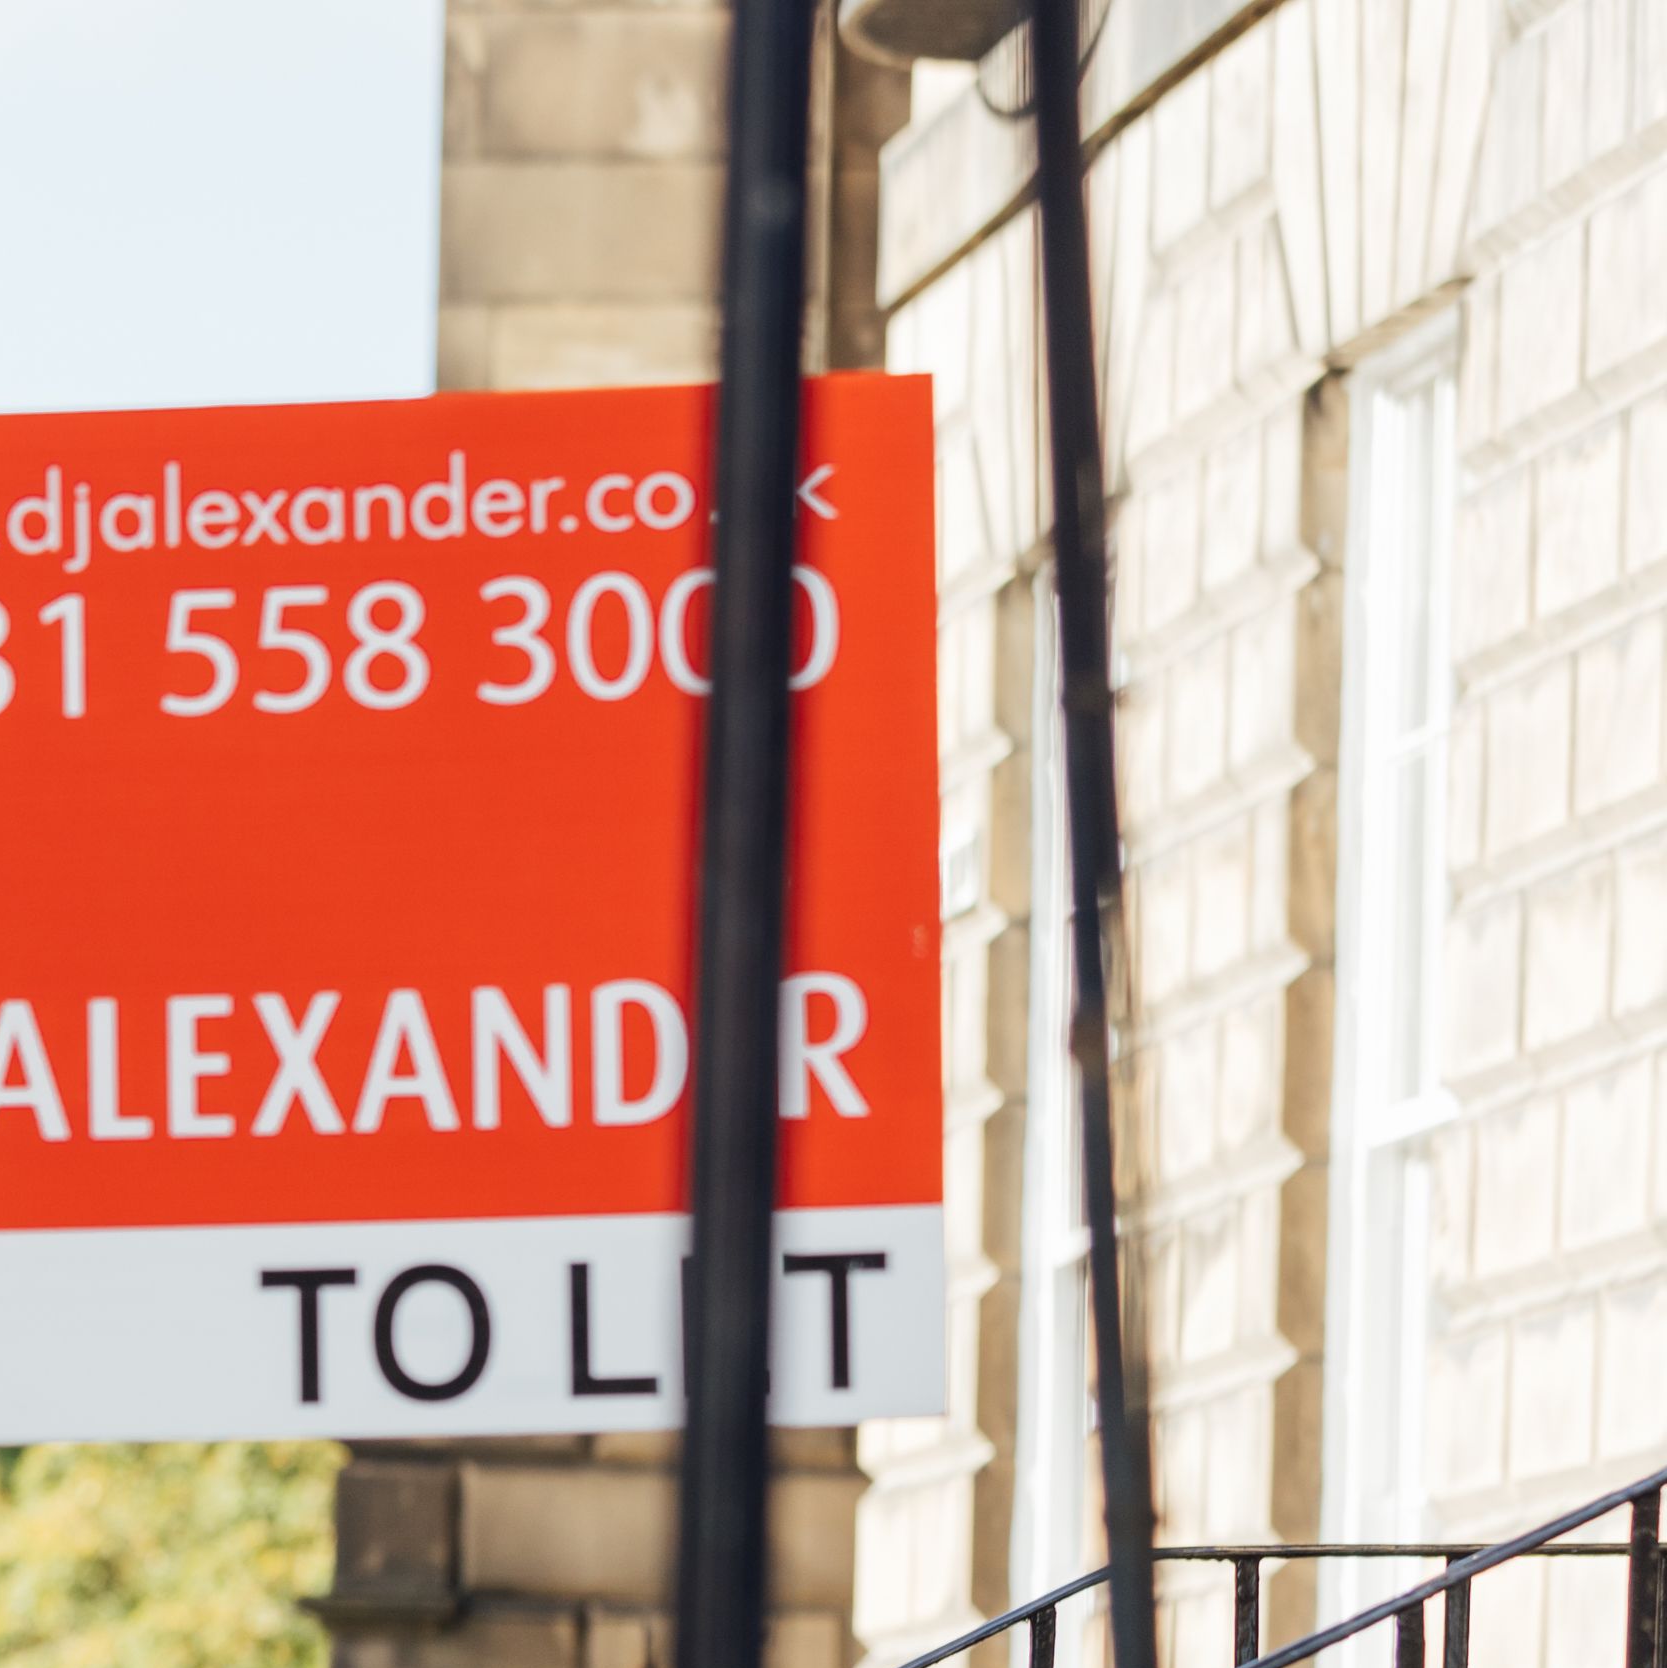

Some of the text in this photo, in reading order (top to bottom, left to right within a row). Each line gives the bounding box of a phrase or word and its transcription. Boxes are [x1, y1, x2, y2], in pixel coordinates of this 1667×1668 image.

[159, 580, 431, 718] 558
[476, 564, 840, 705] 3000
[260, 1251, 888, 1404] TO LT
